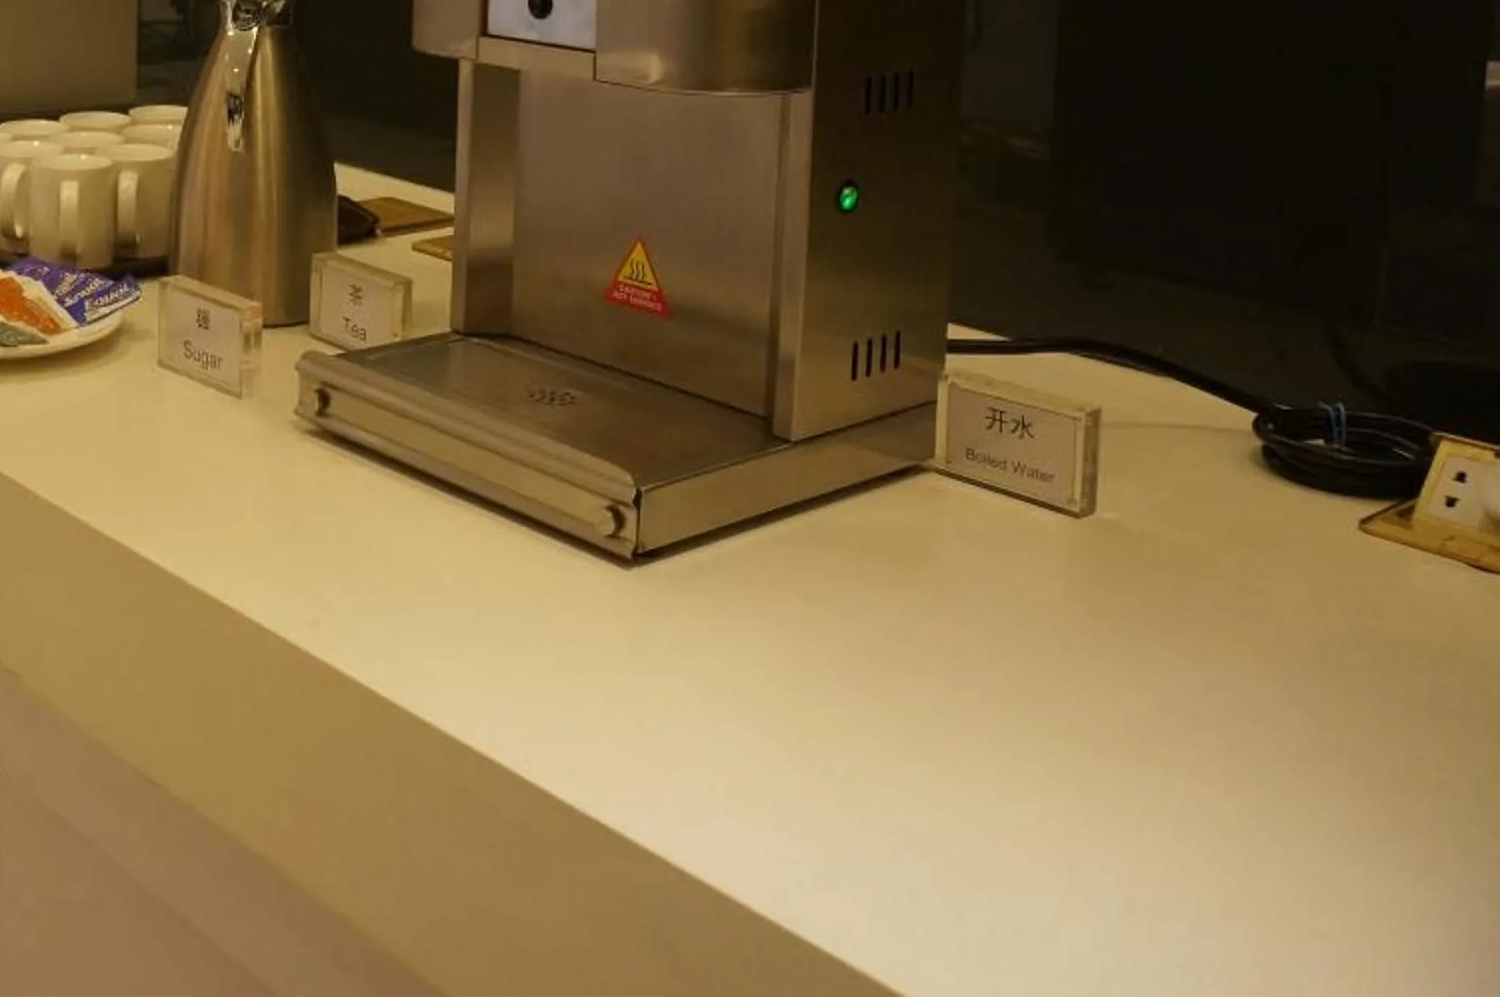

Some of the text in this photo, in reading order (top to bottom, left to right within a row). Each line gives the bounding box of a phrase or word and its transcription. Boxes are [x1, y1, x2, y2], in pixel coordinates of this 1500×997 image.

[342, 316, 367, 342] Tea
[182, 339, 224, 372] Sugar
[985, 406, 1035, 440] 开水
[964, 447, 1056, 483] Boiled Water
